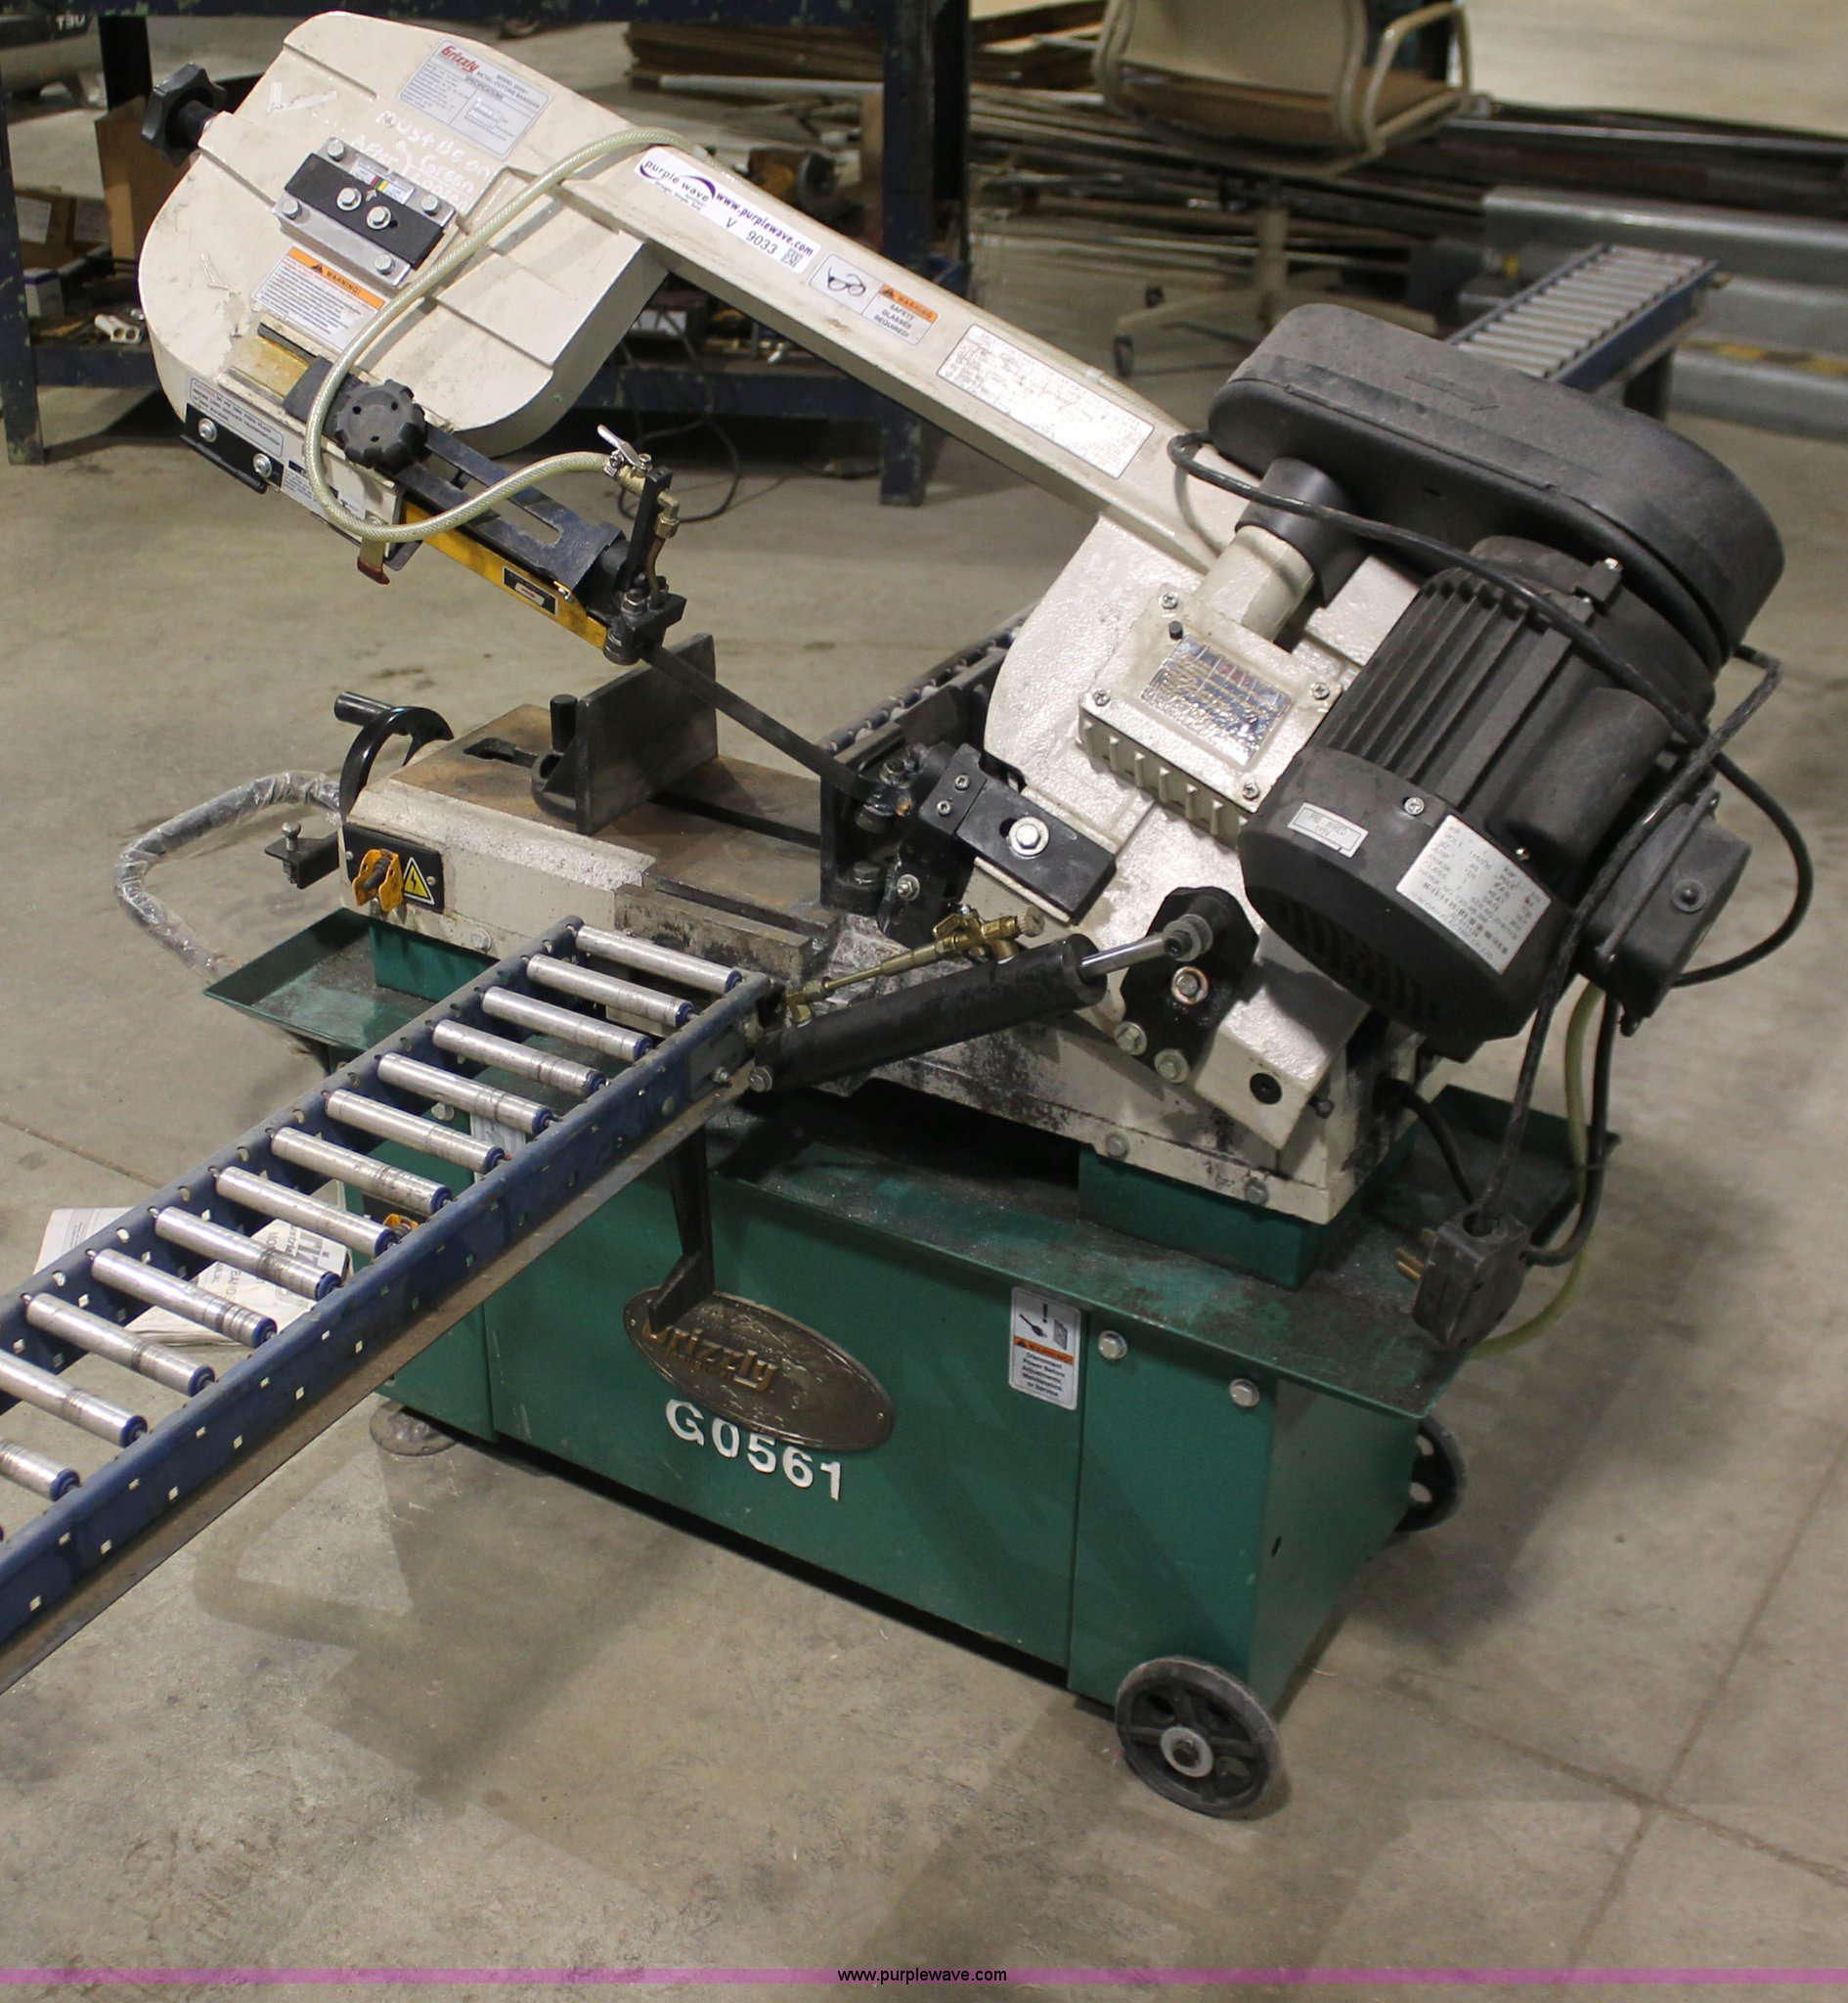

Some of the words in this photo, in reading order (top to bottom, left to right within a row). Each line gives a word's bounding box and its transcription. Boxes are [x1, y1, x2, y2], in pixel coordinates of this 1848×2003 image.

[441, 46, 479, 74] Grizzly
[643, 159, 680, 184] purple
[682, 181, 710, 202] wave
[716, 191, 814, 257] www.purplewave.com
[726, 216, 737, 229] V
[745, 230, 778, 255] 9033
[326, 269, 362, 295] WARNING!
[881, 309, 913, 330] GLASSES
[889, 303, 915, 321] SAFETY
[665, 1399, 841, 1501] G0561
